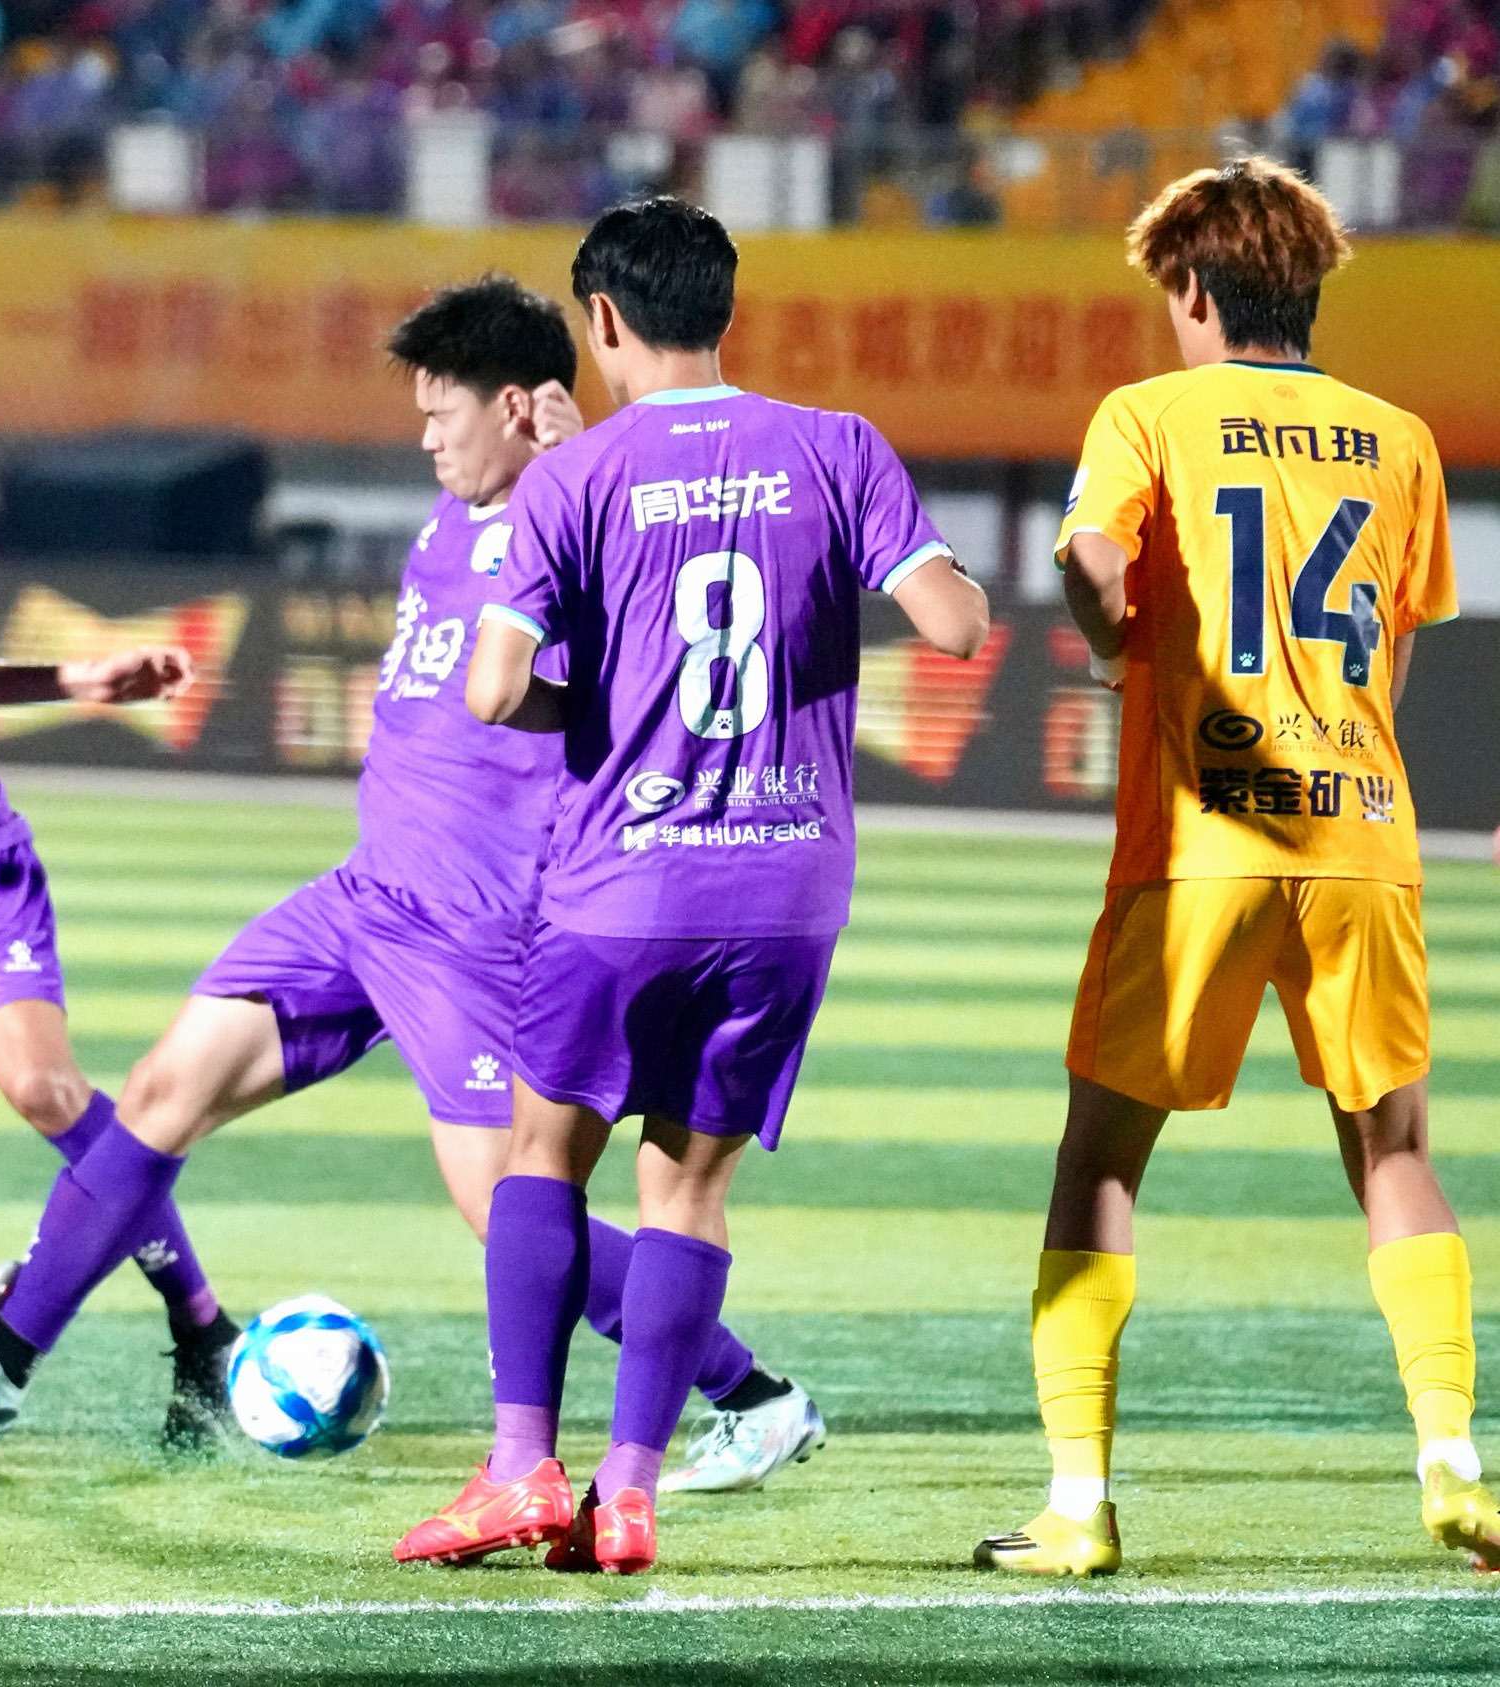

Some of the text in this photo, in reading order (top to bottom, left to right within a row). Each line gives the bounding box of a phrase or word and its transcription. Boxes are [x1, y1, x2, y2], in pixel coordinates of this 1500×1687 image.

[1220, 417, 1381, 470] 武凡琪
[630, 469, 792, 532] 周华龙
[1214, 485, 1383, 689] 14
[674, 550, 770, 740] 8
[693, 762, 820, 799] 兴业银行
[1200, 767, 1396, 825] 紫金矿业
